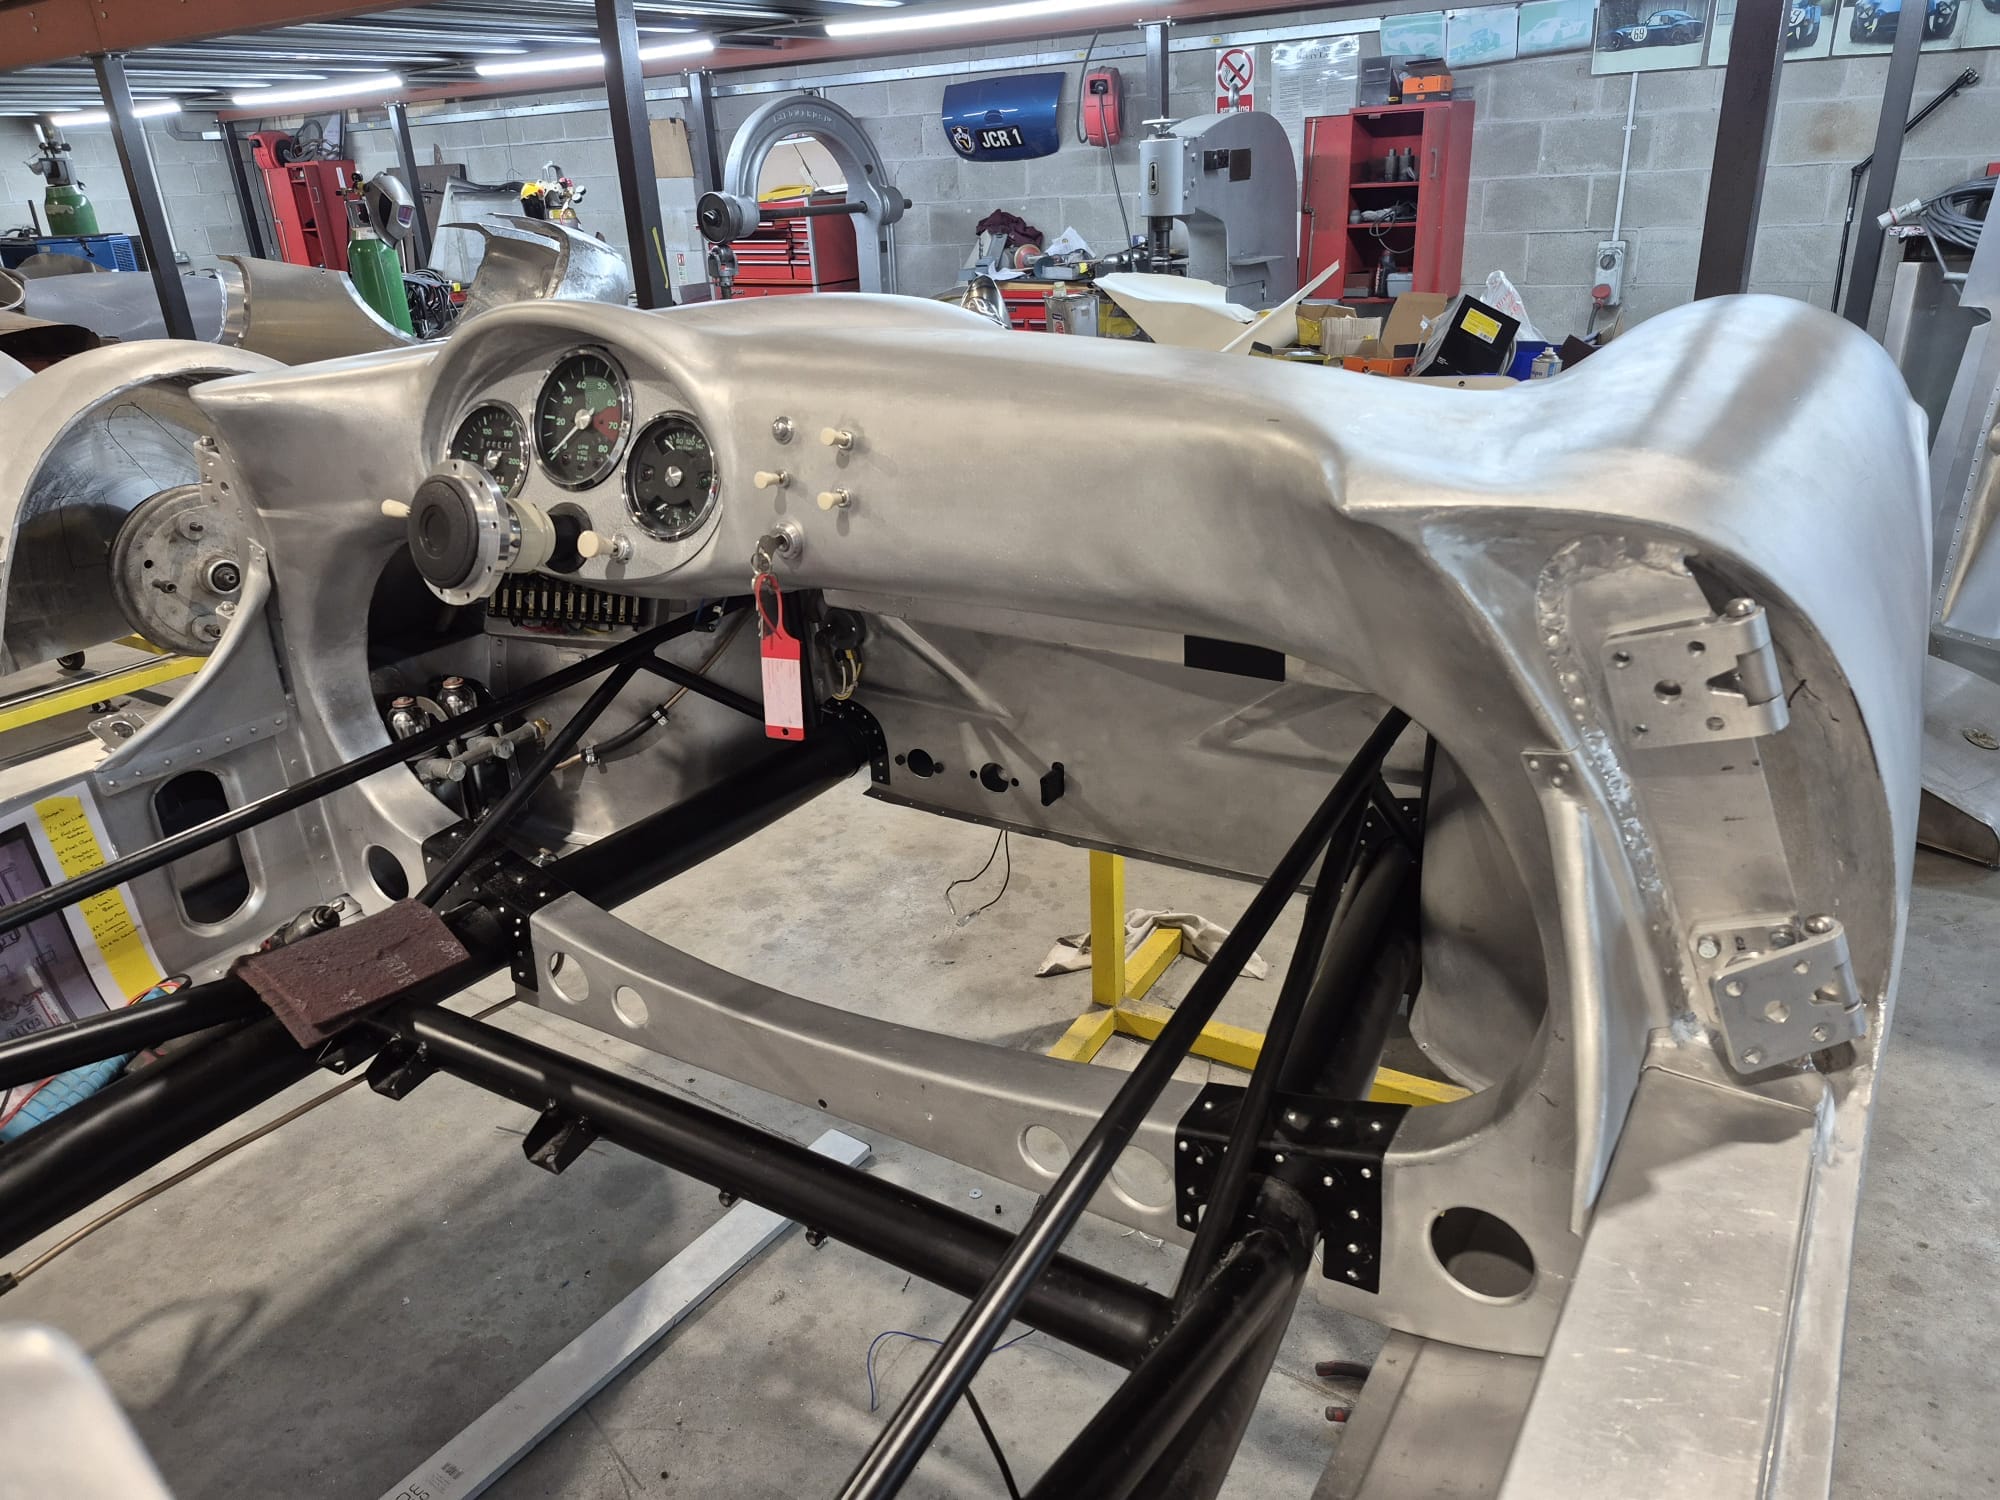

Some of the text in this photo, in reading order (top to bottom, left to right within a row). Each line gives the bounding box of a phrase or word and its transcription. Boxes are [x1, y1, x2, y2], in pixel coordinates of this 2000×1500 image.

[1633, 27, 1645, 40] 69
[981, 130, 1012, 149] JCR
[1012, 128, 1022, 145] 1
[576, 380, 586, 389] 40
[597, 382, 607, 390] 50
[607, 398, 617, 407] 60
[556, 417, 566, 426] 20
[608, 421, 618, 430] 70
[598, 444, 608, 453] 80
[470, 453, 479, 461] 50
[508, 457, 520, 465] 200
